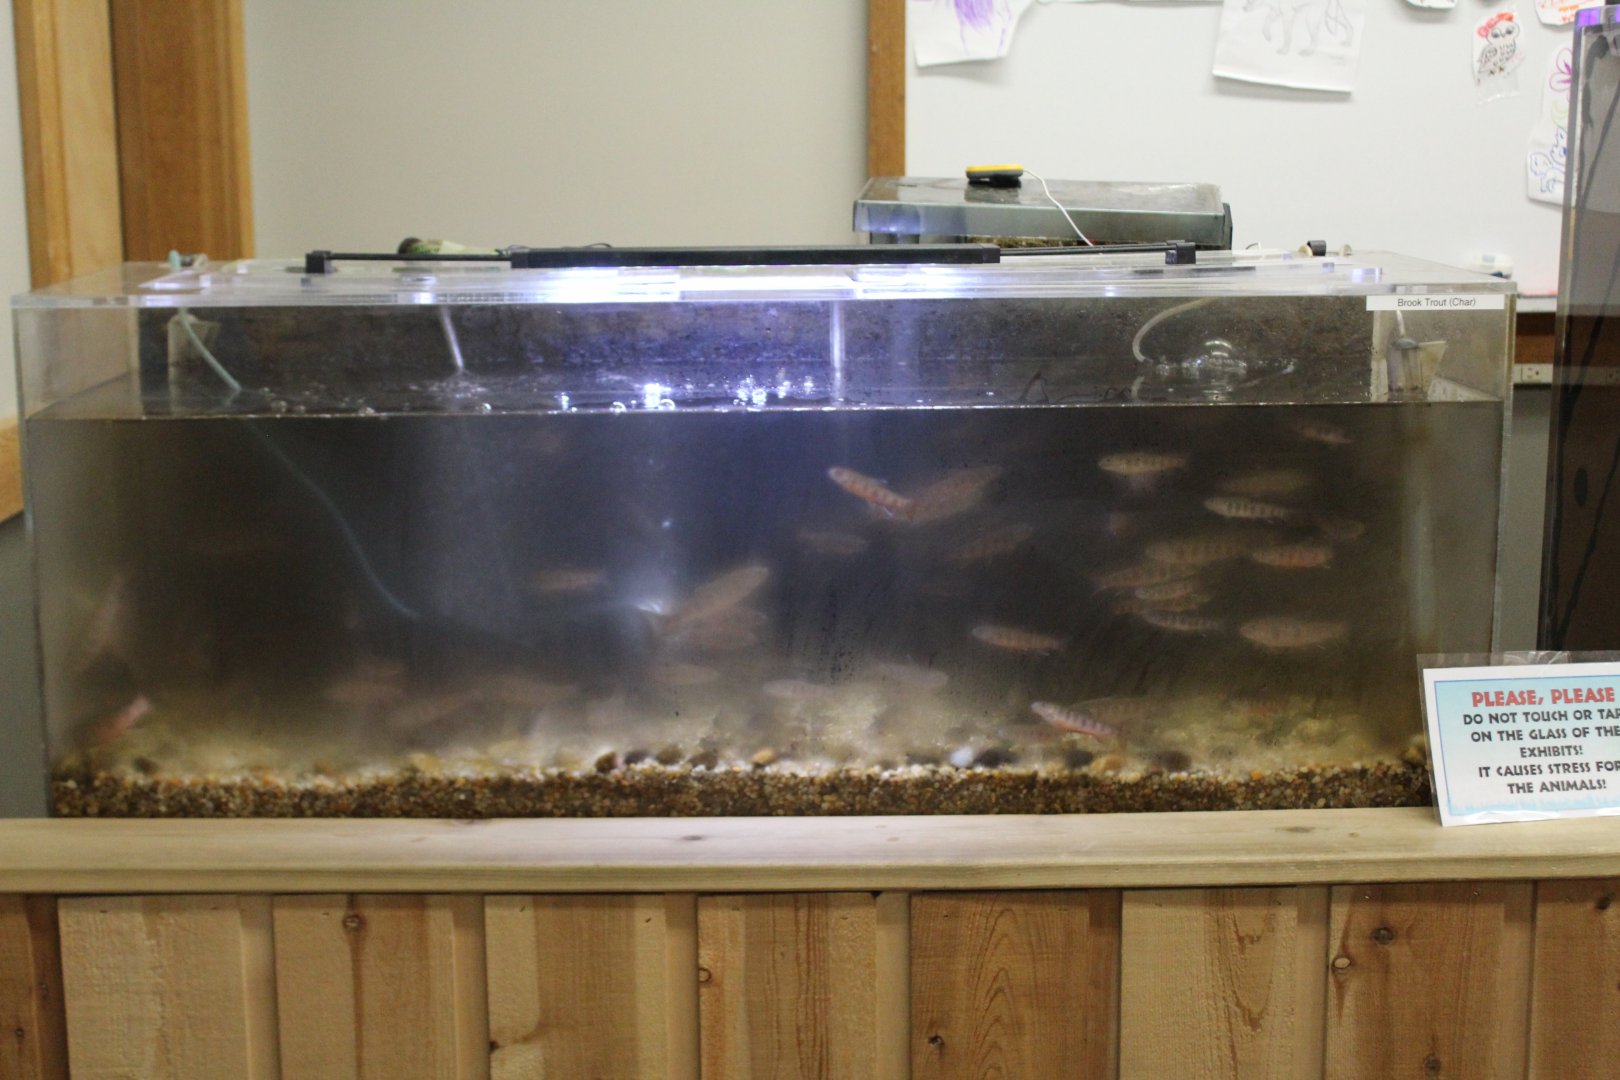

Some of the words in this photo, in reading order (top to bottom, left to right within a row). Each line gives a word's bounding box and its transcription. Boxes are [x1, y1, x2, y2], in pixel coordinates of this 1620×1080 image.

[1397, 298, 1422, 307] Brook
[1425, 297, 1447, 307] Trout
[1449, 297, 1476, 307] (Char)
[1471, 690, 1544, 708] PLEASE,
[1551, 687, 1616, 704] PLEASE
[1463, 713, 1483, 725] DO
[1488, 712, 1517, 724] NOT
[1523, 710, 1568, 722] TOUCH
[1573, 709, 1592, 720] OR
[1471, 731, 1493, 743] ON
[1497, 730, 1524, 741] THE
[1529, 728, 1567, 740] GLASS
[1572, 727, 1590, 738] OF
[1595, 725, 1620, 737] THE
[1519, 745, 1583, 758] EXHIBITS!
[1478, 766, 1491, 778] IT
[1496, 764, 1543, 775] CAUSES
[1547, 762, 1591, 774] STRESS
[1507, 782, 1534, 794] THE
[1539, 779, 1607, 793] ANIMALS!
